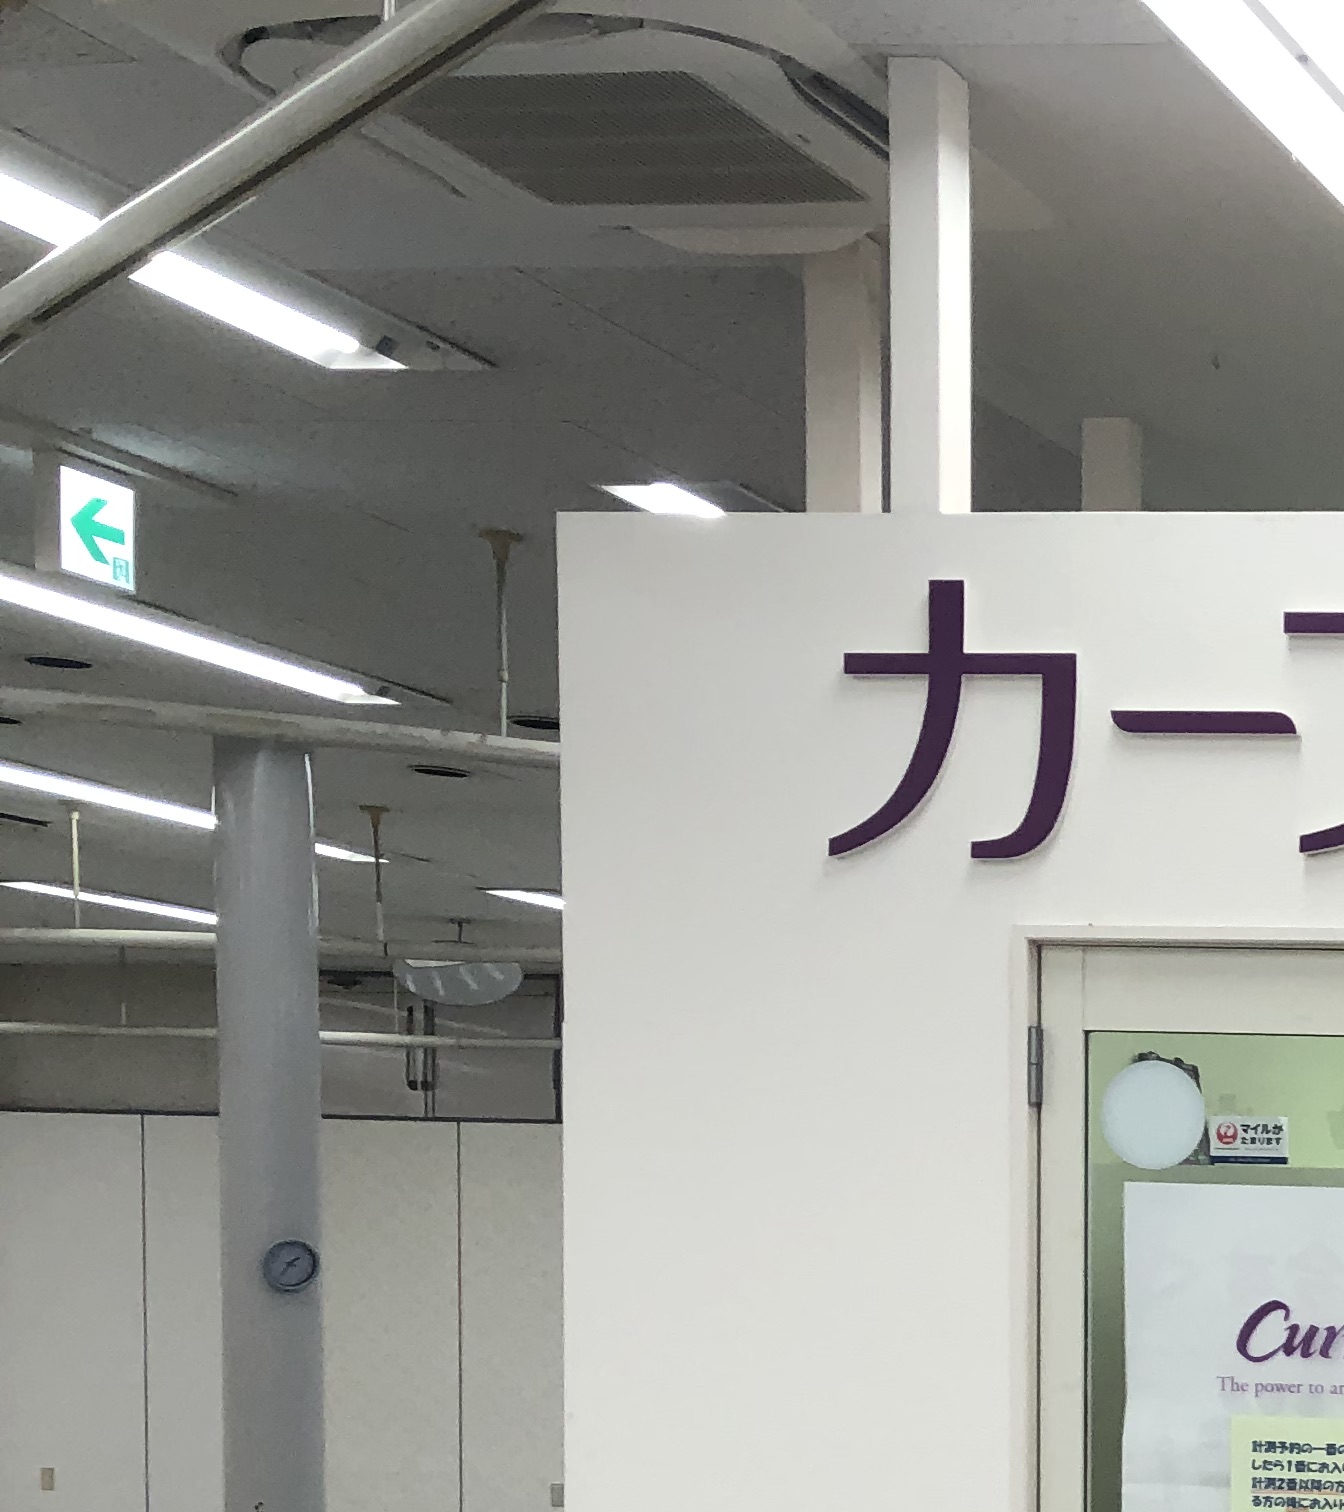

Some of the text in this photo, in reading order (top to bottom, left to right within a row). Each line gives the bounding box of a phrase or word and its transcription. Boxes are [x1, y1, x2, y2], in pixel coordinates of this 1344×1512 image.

[1216, 1375, 1249, 1393] The
[1254, 1382, 1303, 1398] power
[1308, 1384, 1324, 1395] to
